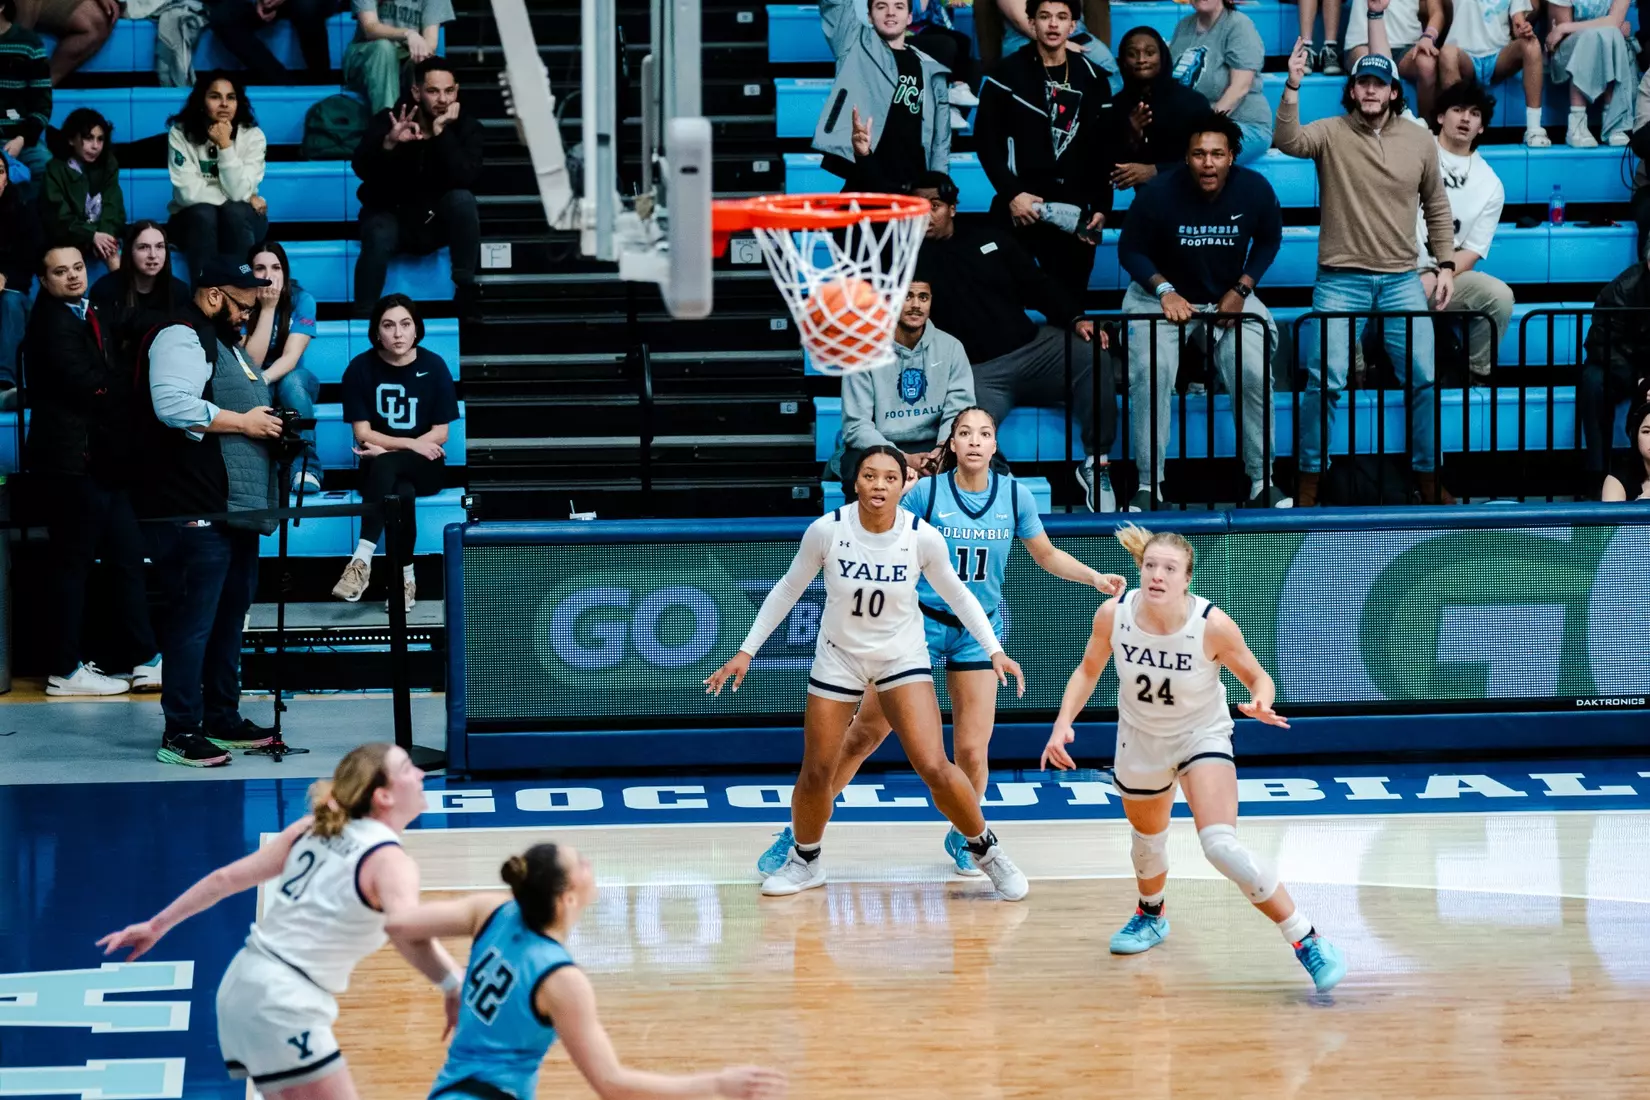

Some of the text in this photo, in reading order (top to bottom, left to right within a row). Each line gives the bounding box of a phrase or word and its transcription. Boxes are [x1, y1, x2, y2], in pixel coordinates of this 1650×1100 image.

[1178, 225, 1239, 235] COLUMBIA
[1180, 238, 1235, 246] FOOTBALL
[739, 244, 754, 263] G
[885, 405, 944, 419] FOOTBALL
[937, 526, 1010, 540] COLUMBIA
[838, 559, 907, 582] YALE
[955, 546, 988, 582] 11
[851, 588, 885, 618] 10
[550, 585, 720, 670] GO
[1120, 643, 1193, 671] YALE
[1136, 674, 1175, 706] 24
[1575, 698, 1646, 707] DAKTRONICS
[466, 949, 517, 1024] 42
[288, 1030, 314, 1061] Y
